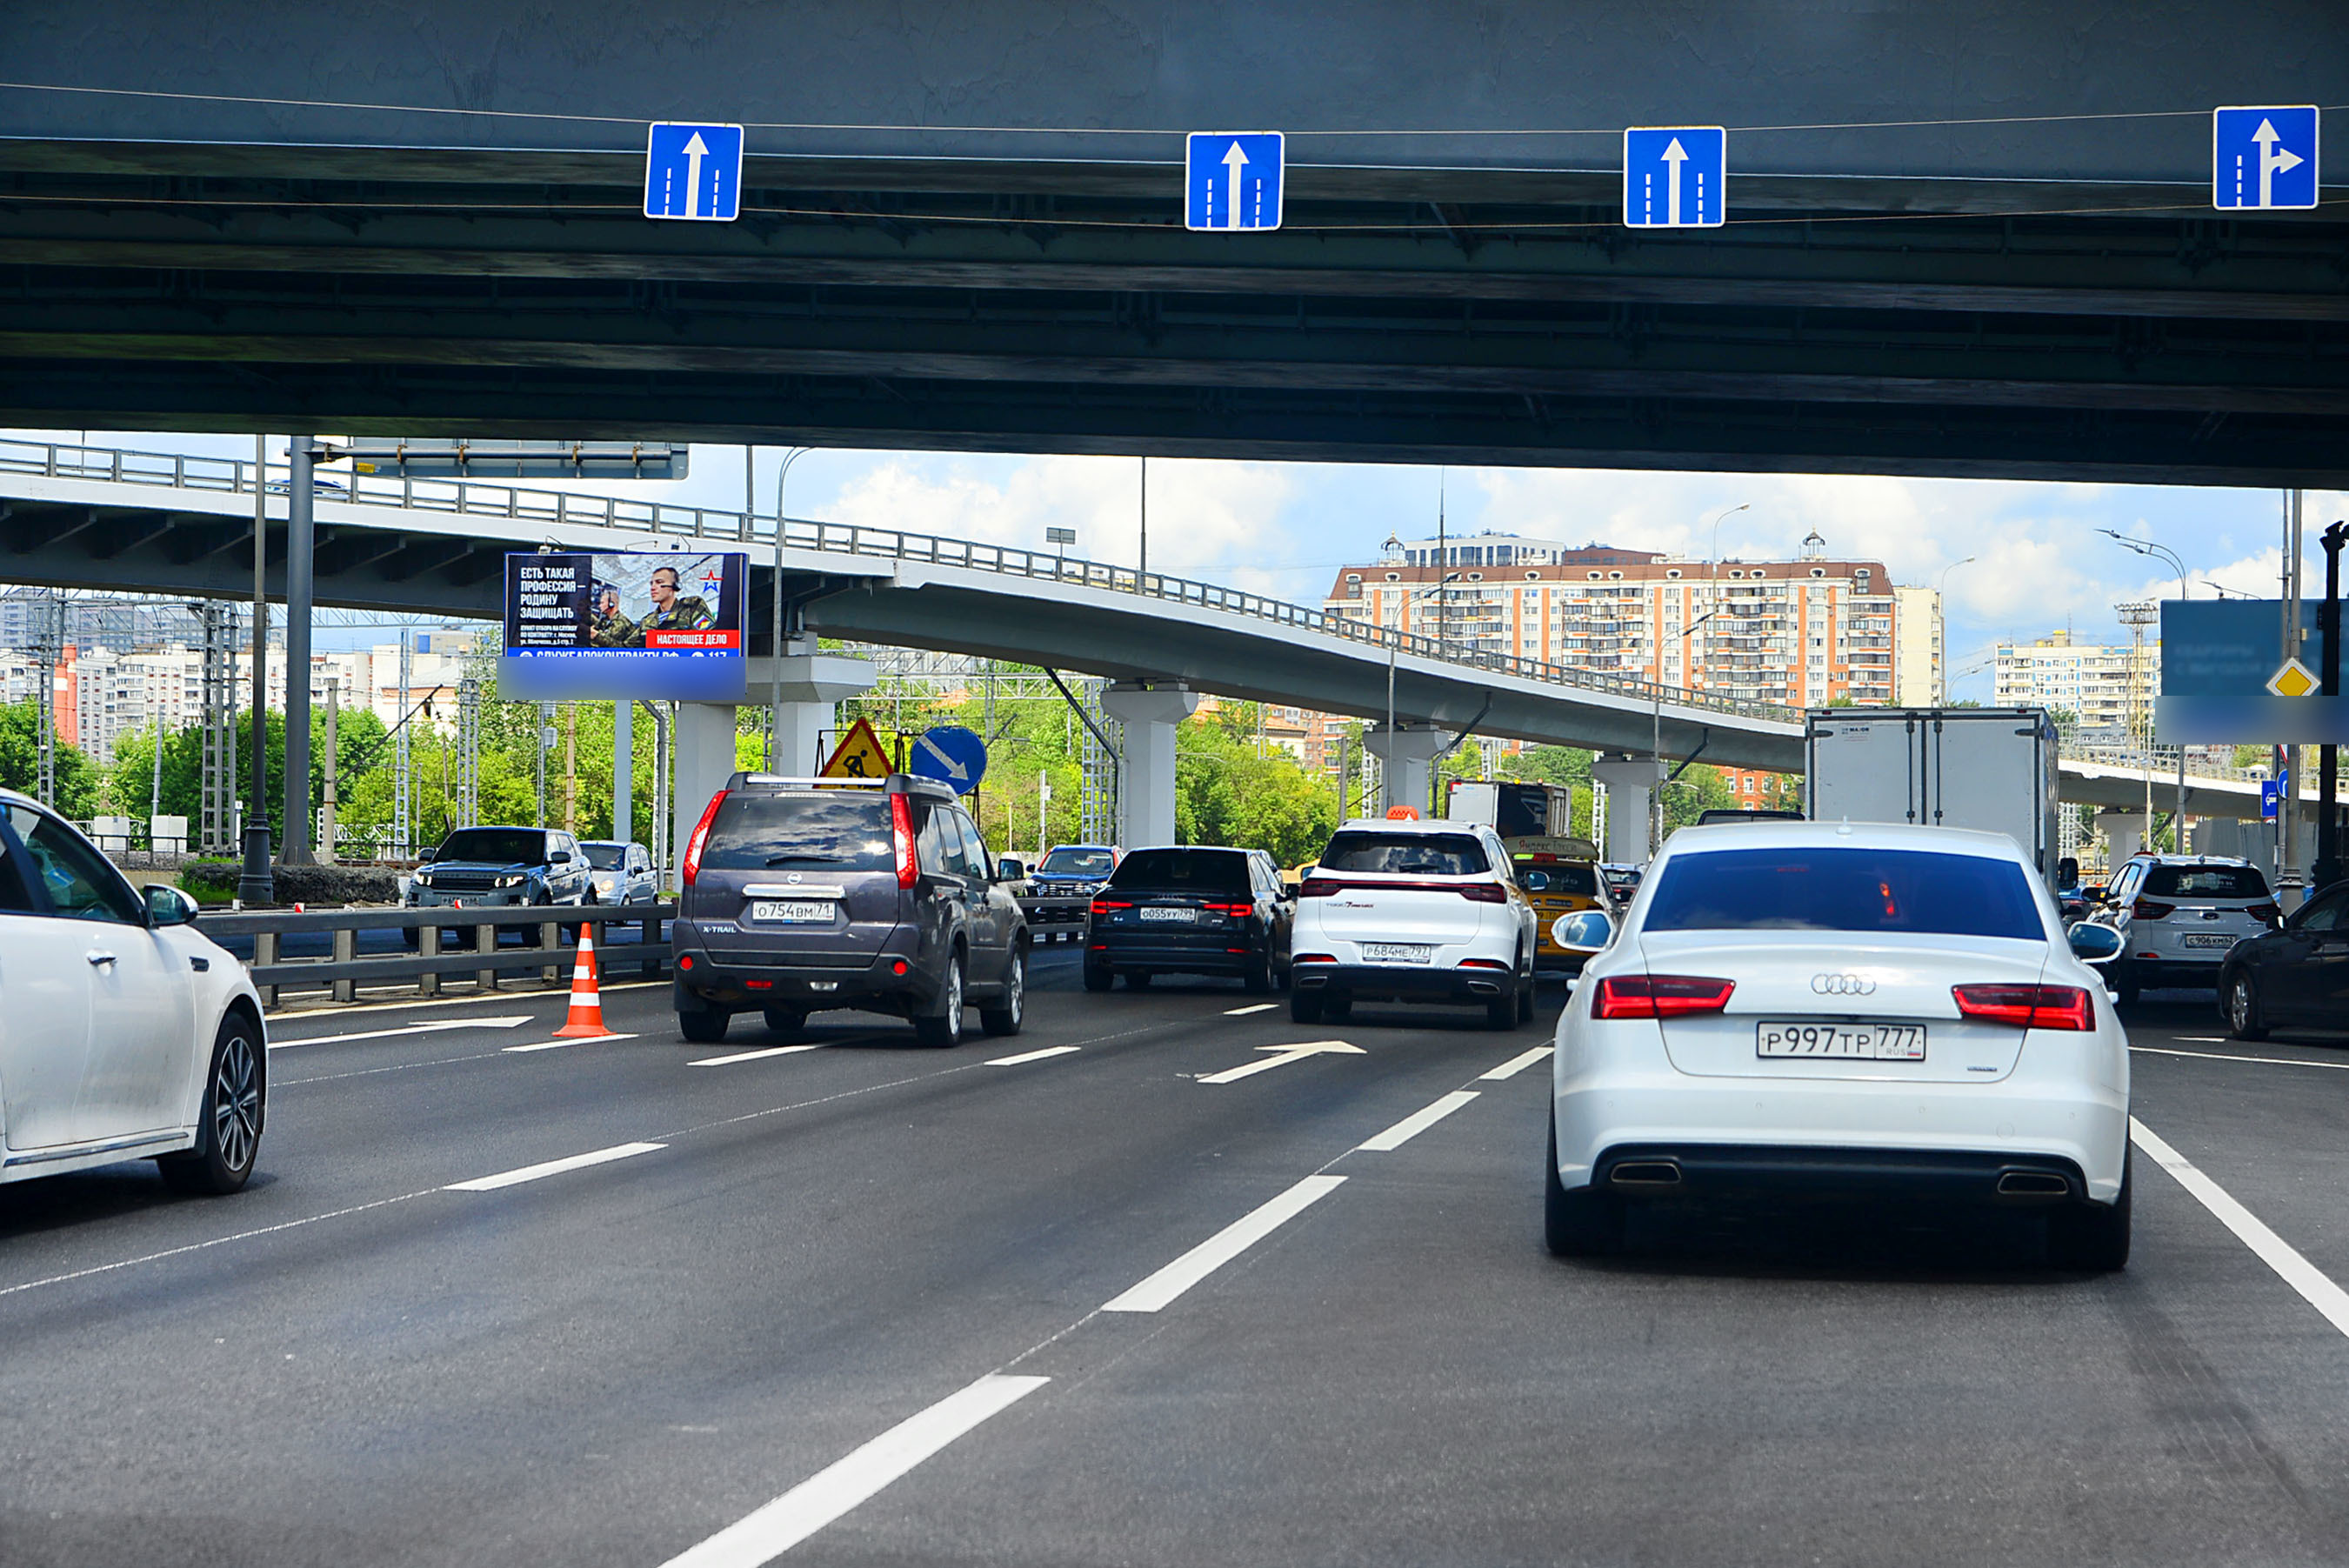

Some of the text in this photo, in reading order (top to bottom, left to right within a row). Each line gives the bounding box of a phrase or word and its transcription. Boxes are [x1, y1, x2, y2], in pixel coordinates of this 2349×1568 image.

[521, 568, 575, 579] ЕСТЬ ТАКАЯ
[521, 581, 577, 592] ПРОФЕССИЯ
[520, 594, 557, 606] РОДИНУ
[520, 607, 574, 619] ЗАЩИЩАТЬ
[657, 634, 727, 645] НАСТОЯЩЕЕ ДЕЛО
[1519, 839, 1551, 851] Яндекс
[1877, 1027, 1918, 1048] 777
[1886, 1047, 1906, 1057] RUS
